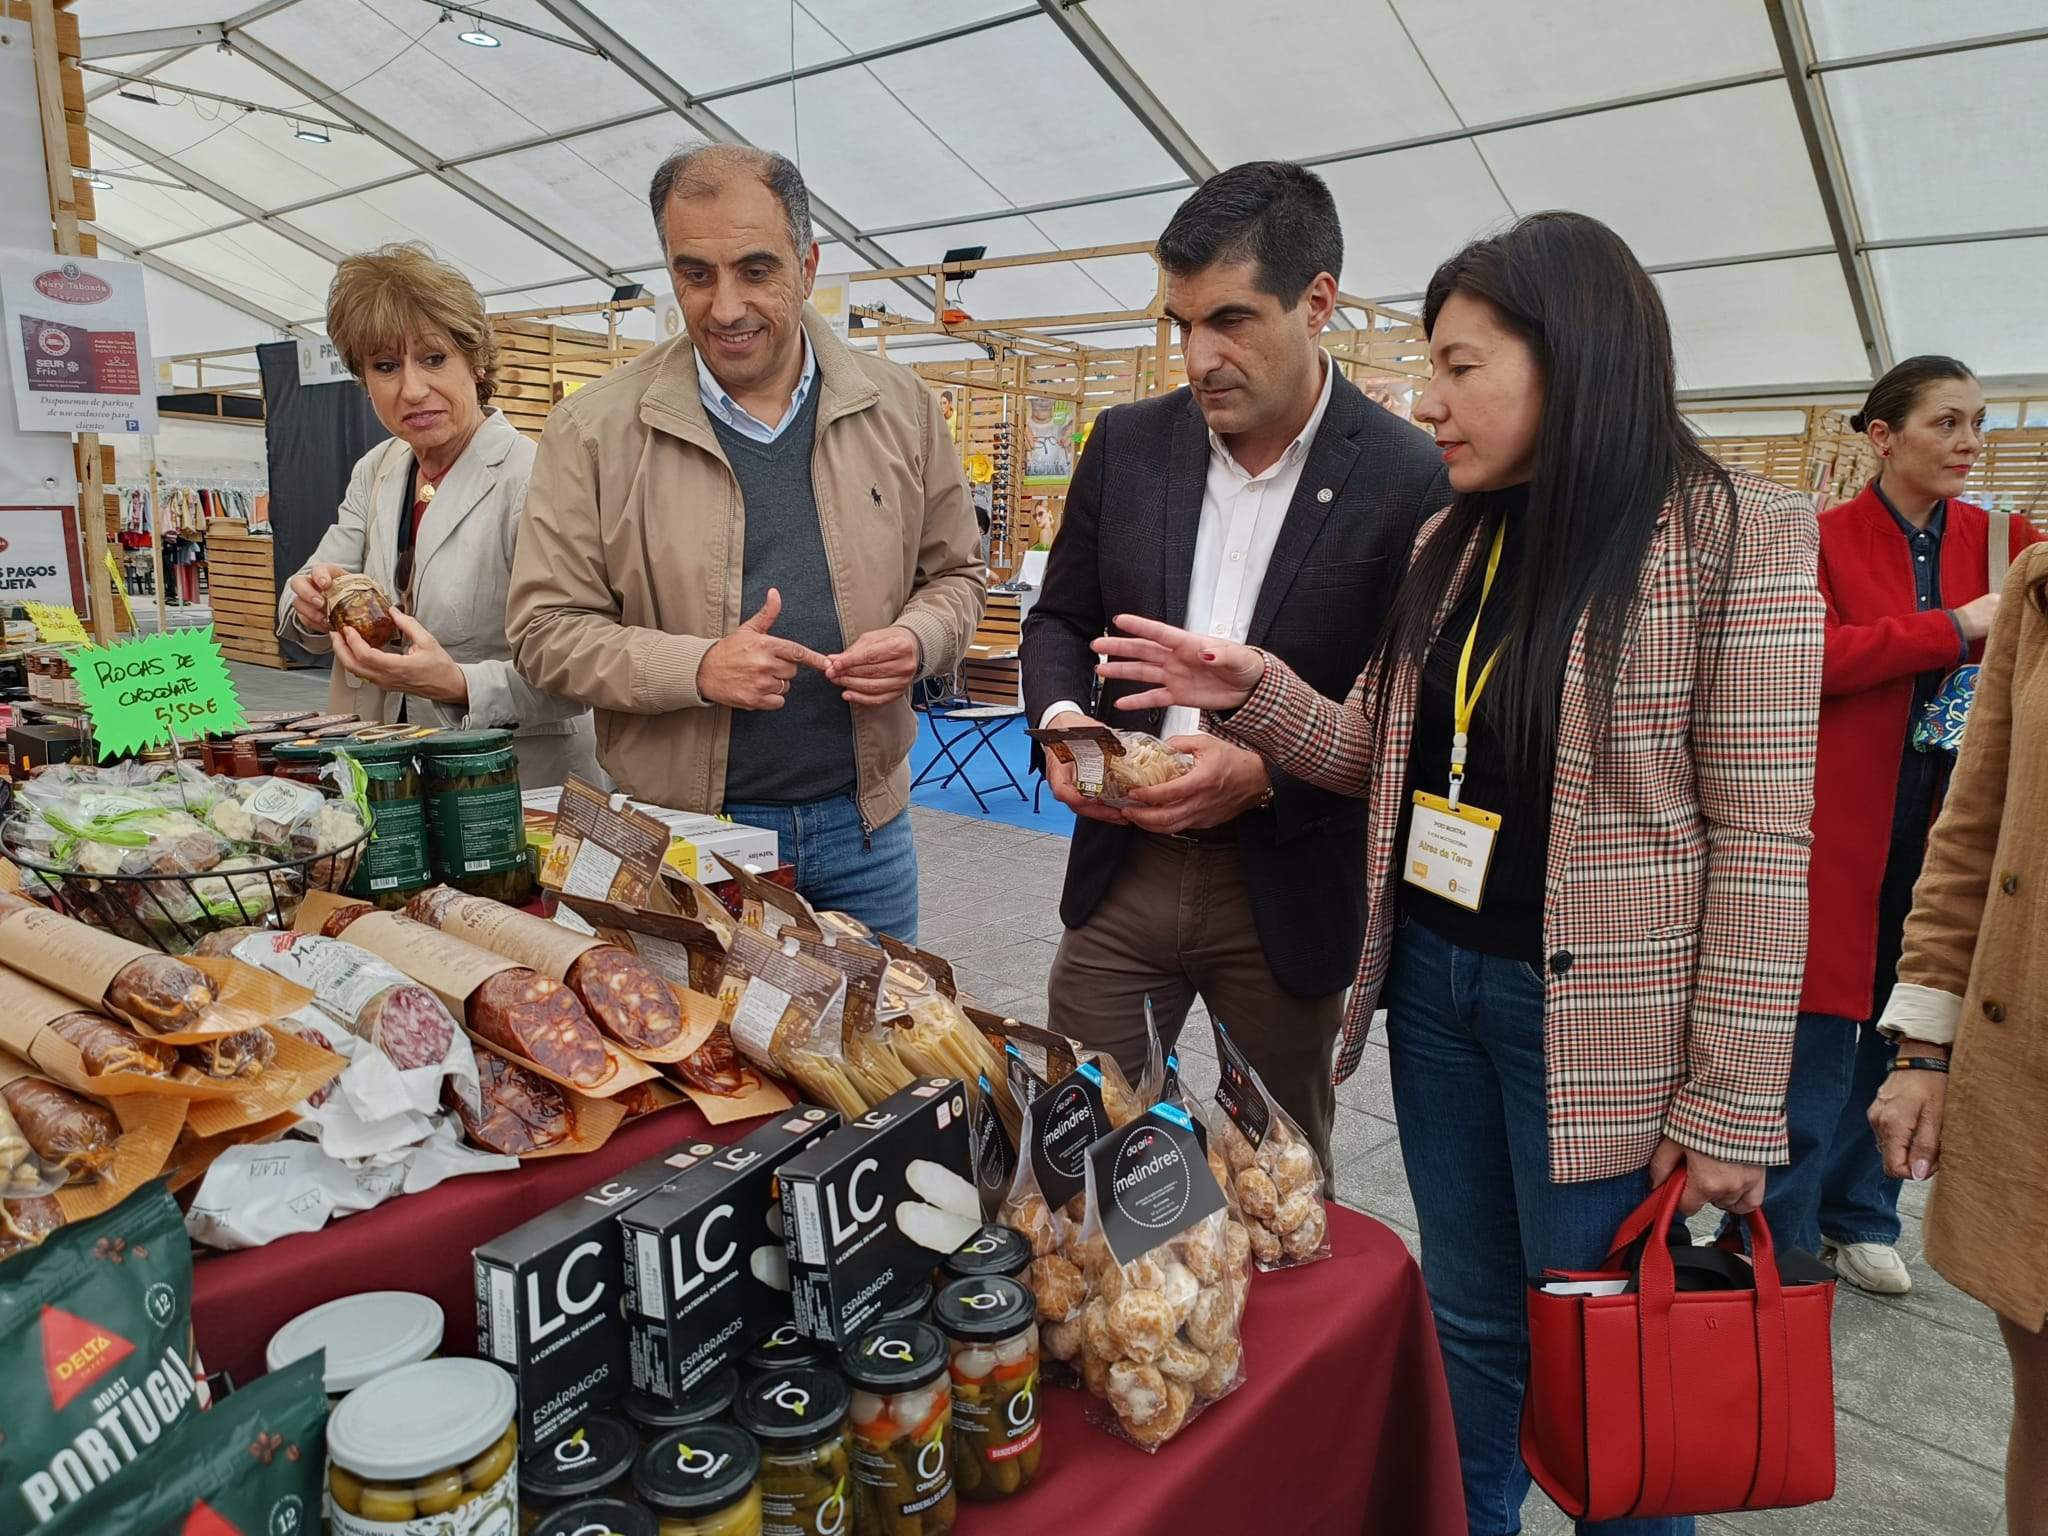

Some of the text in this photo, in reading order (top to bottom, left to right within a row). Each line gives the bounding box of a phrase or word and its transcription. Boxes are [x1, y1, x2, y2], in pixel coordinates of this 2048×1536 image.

[36, 359, 64, 368] SEUR
[40, 396, 134, 410] Disponemos de parking
[48, 408, 57, 416] de
[74, 410, 110, 418] exclusivo
[112, 412, 130, 421] para
[75, 422, 104, 430] clientes
[6, 566, 56, 578] PAGOS
[94, 654, 196, 688] ROCAS DE
[1044, 1106, 1090, 1147] melindres
[1116, 1150, 1180, 1193] melindres
[826, 1158, 884, 1248] LC
[670, 1204, 738, 1301] LC
[154, 1292, 171, 1318] 12
[526, 1240, 606, 1344] LC
[841, 1268, 894, 1319] ESPÁRRAGOS
[56, 1334, 112, 1382] DELTA
[680, 1316, 744, 1375] ESPÁRRAGOS
[92, 1376, 130, 1414] ROAST
[533, 1364, 609, 1425] ESPÁRRAGOS
[276, 1506, 298, 1536] 12
